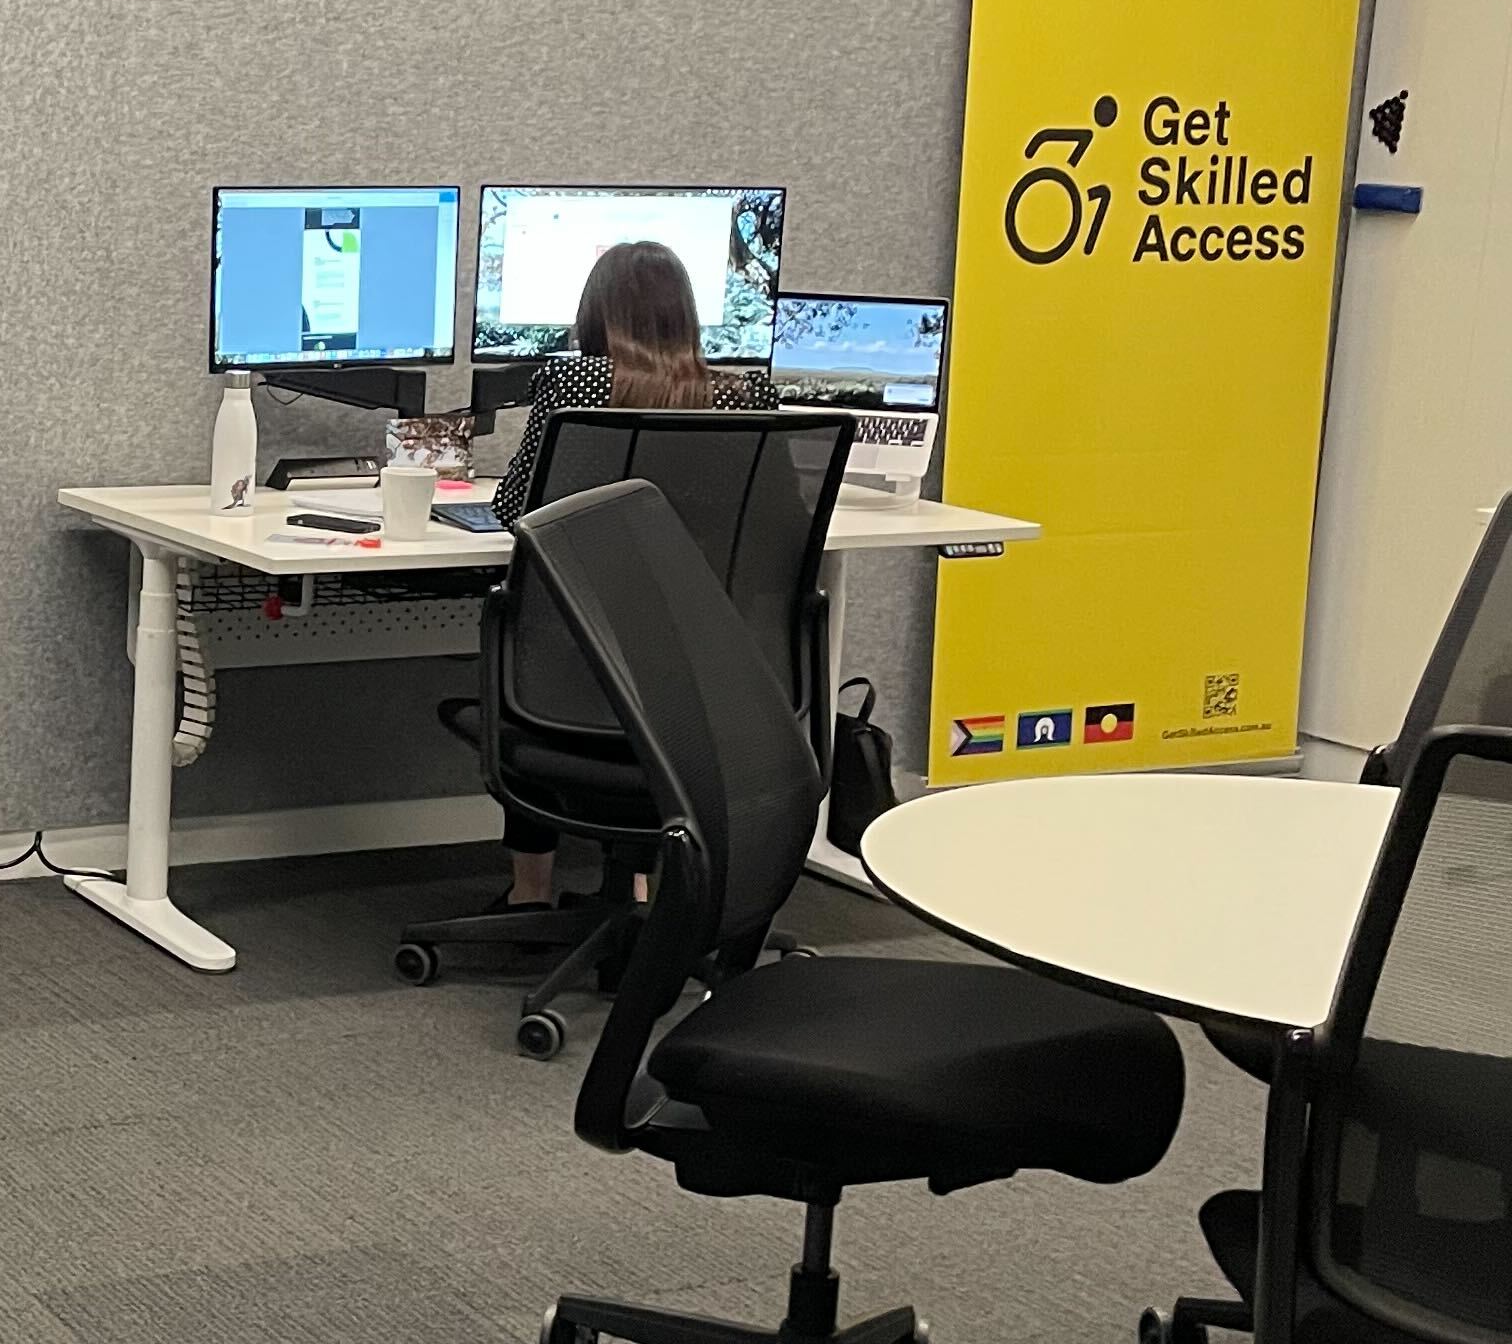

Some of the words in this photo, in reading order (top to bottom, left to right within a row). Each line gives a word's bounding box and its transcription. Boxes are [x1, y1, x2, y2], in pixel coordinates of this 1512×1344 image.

[1143, 96, 1231, 146] Get
[1138, 154, 1313, 207] Skilled
[1133, 214, 1305, 263] Access
